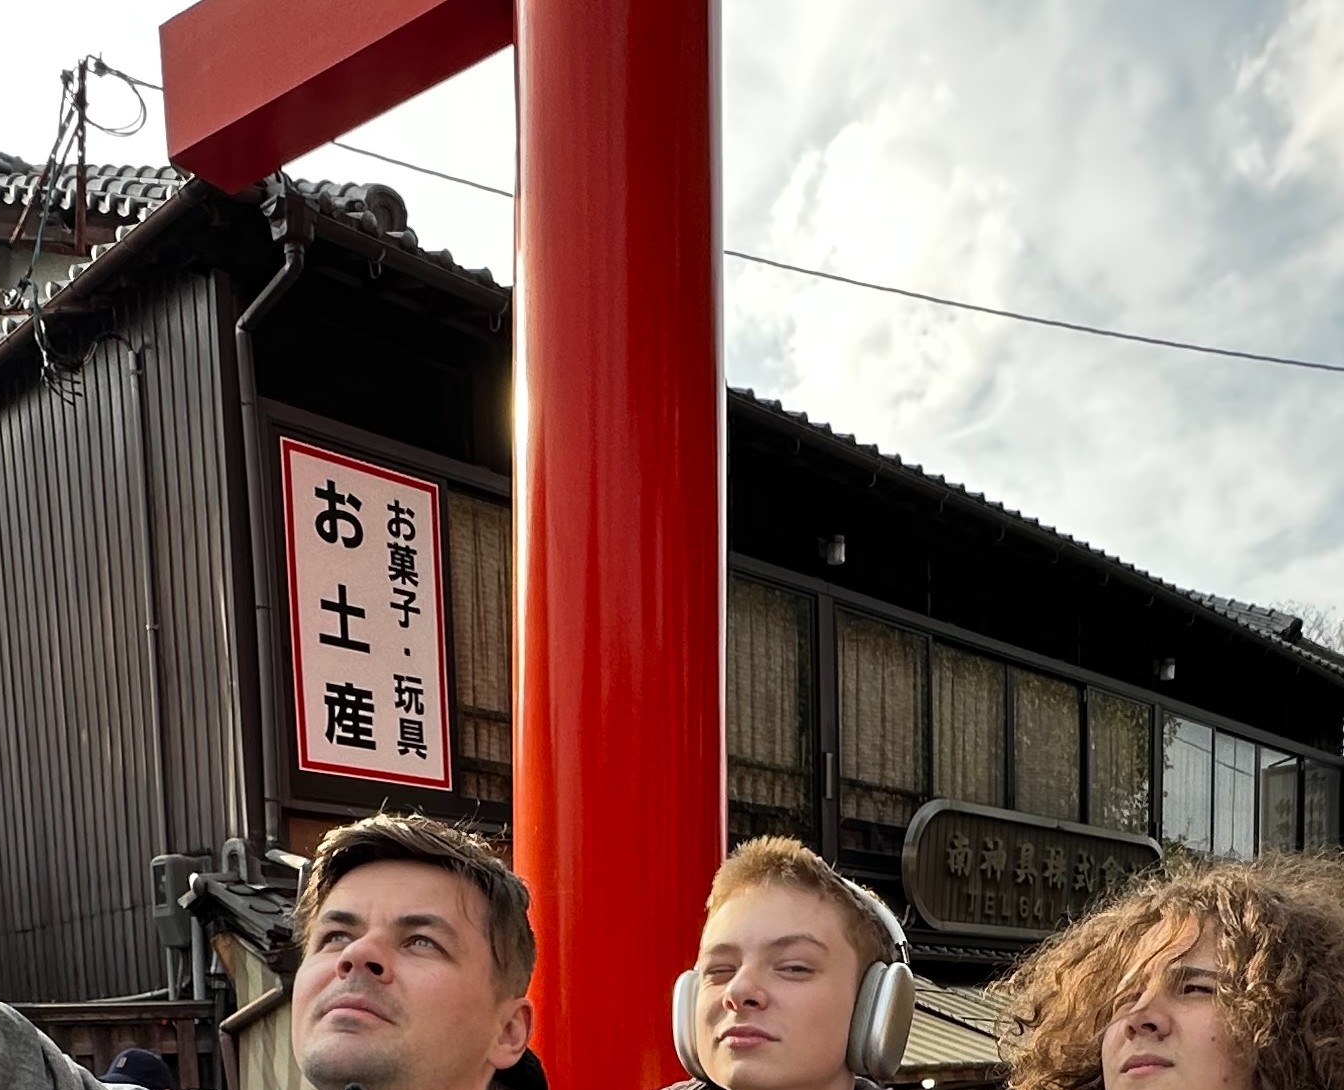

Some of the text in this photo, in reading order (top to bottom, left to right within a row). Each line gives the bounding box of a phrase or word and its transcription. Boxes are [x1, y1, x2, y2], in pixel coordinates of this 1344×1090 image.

[314, 479, 377, 751] お土産
[387, 499, 428, 760] お菓子・玩具
